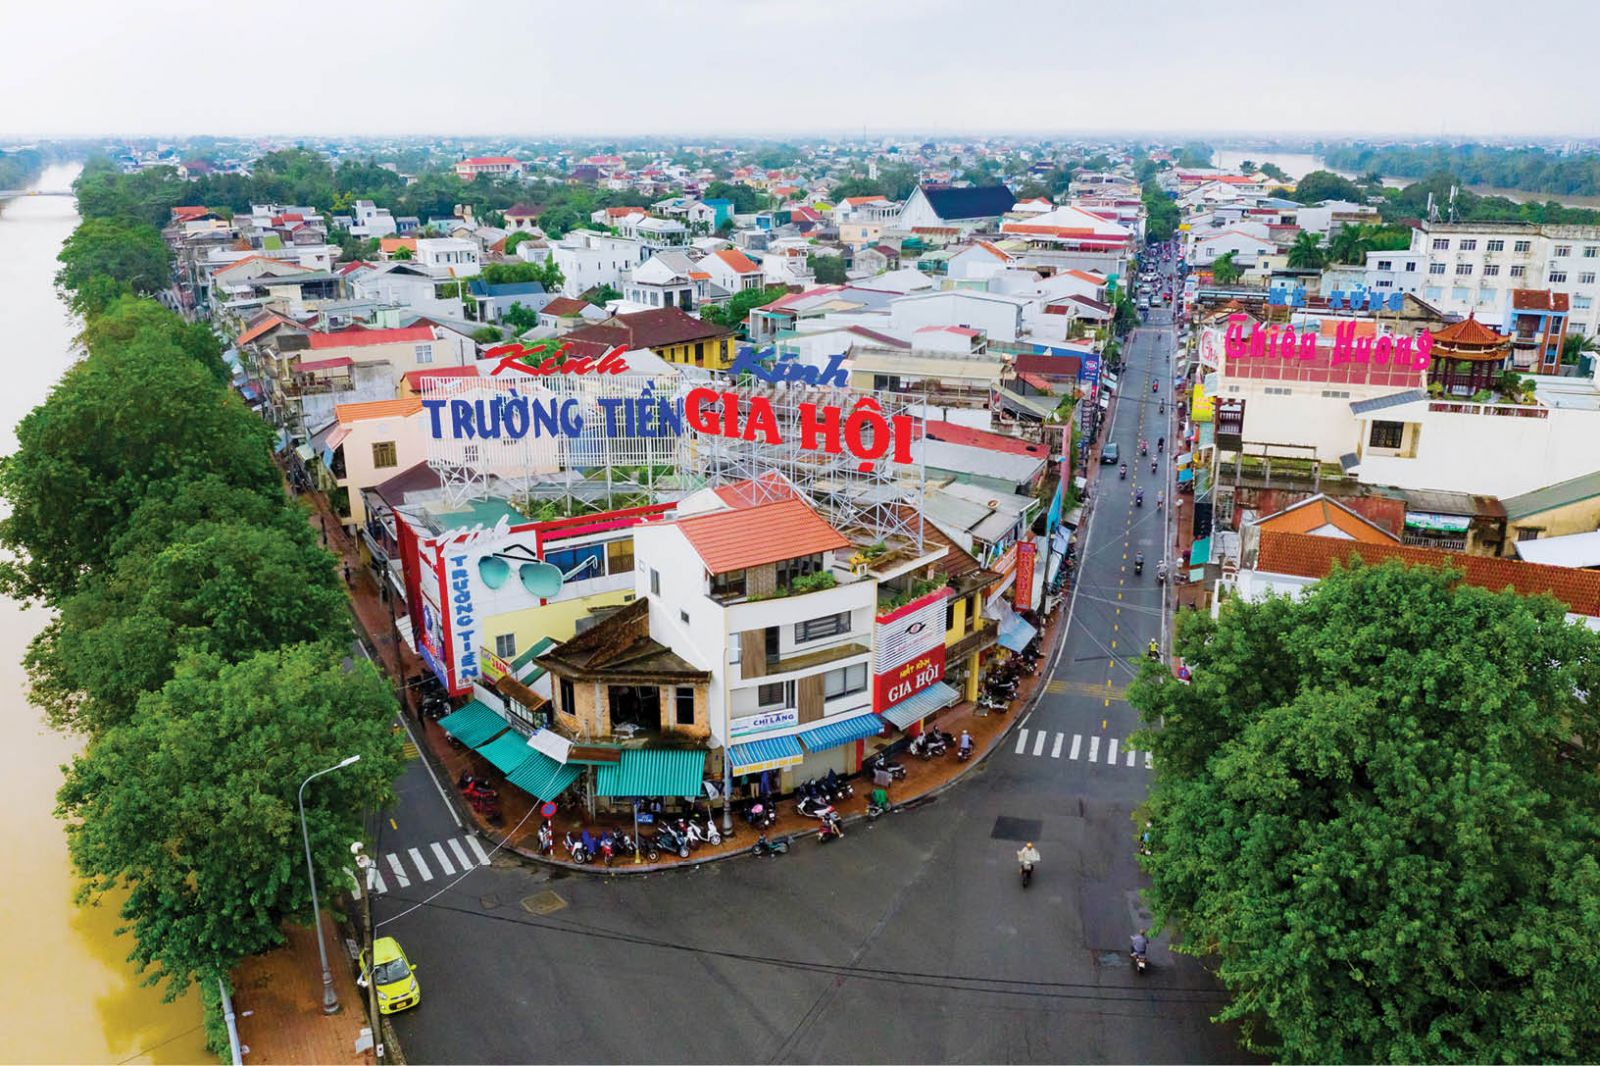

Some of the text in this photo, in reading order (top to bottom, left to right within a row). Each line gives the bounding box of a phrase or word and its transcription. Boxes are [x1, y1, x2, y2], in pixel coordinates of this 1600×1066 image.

[1225, 313, 1316, 360] Thiên
[1331, 321, 1435, 371] Hương
[421, 380, 685, 440] TRƯỜNG TIỀN
[684, 387, 914, 473] GIA HỘI
[888, 663, 940, 702] GIA HỘI
[753, 718, 768, 726] CHI
